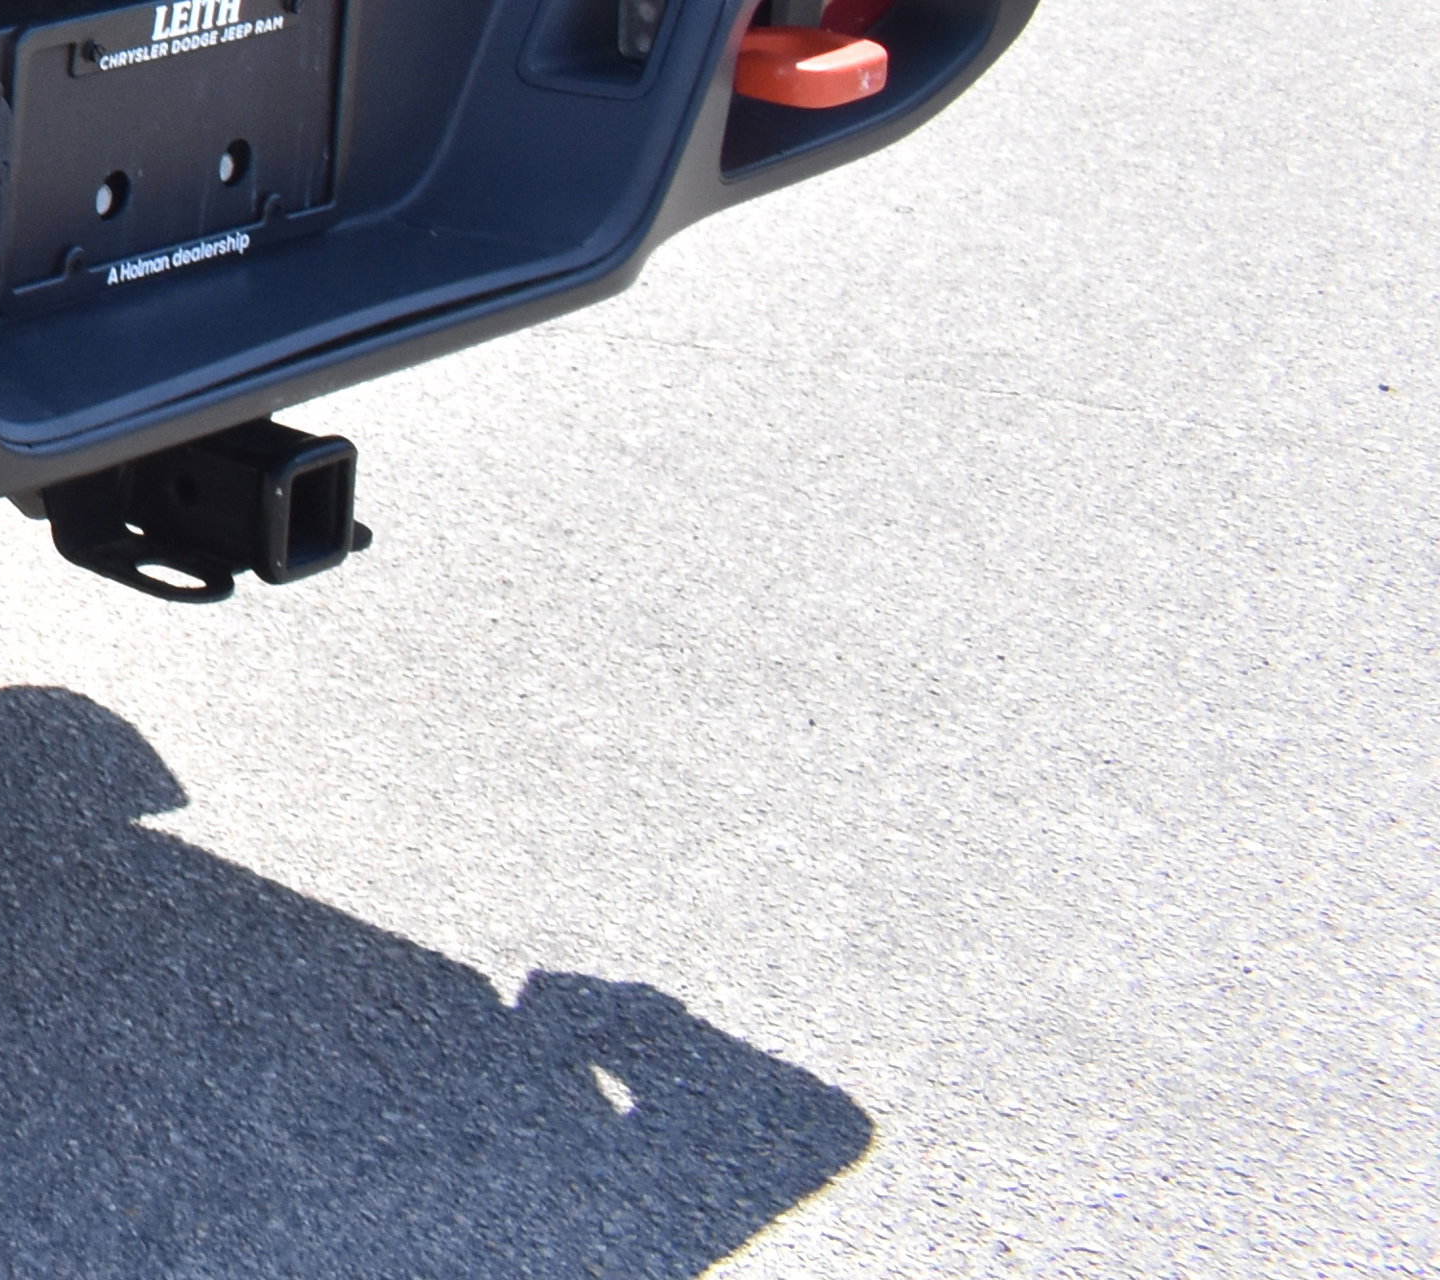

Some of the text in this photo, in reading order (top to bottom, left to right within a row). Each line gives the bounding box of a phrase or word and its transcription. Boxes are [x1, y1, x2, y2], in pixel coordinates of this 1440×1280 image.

[99, 15, 284, 71] CHRYSLER DODGE JEEP RAM
[106, 231, 251, 286] A Holman dealership
